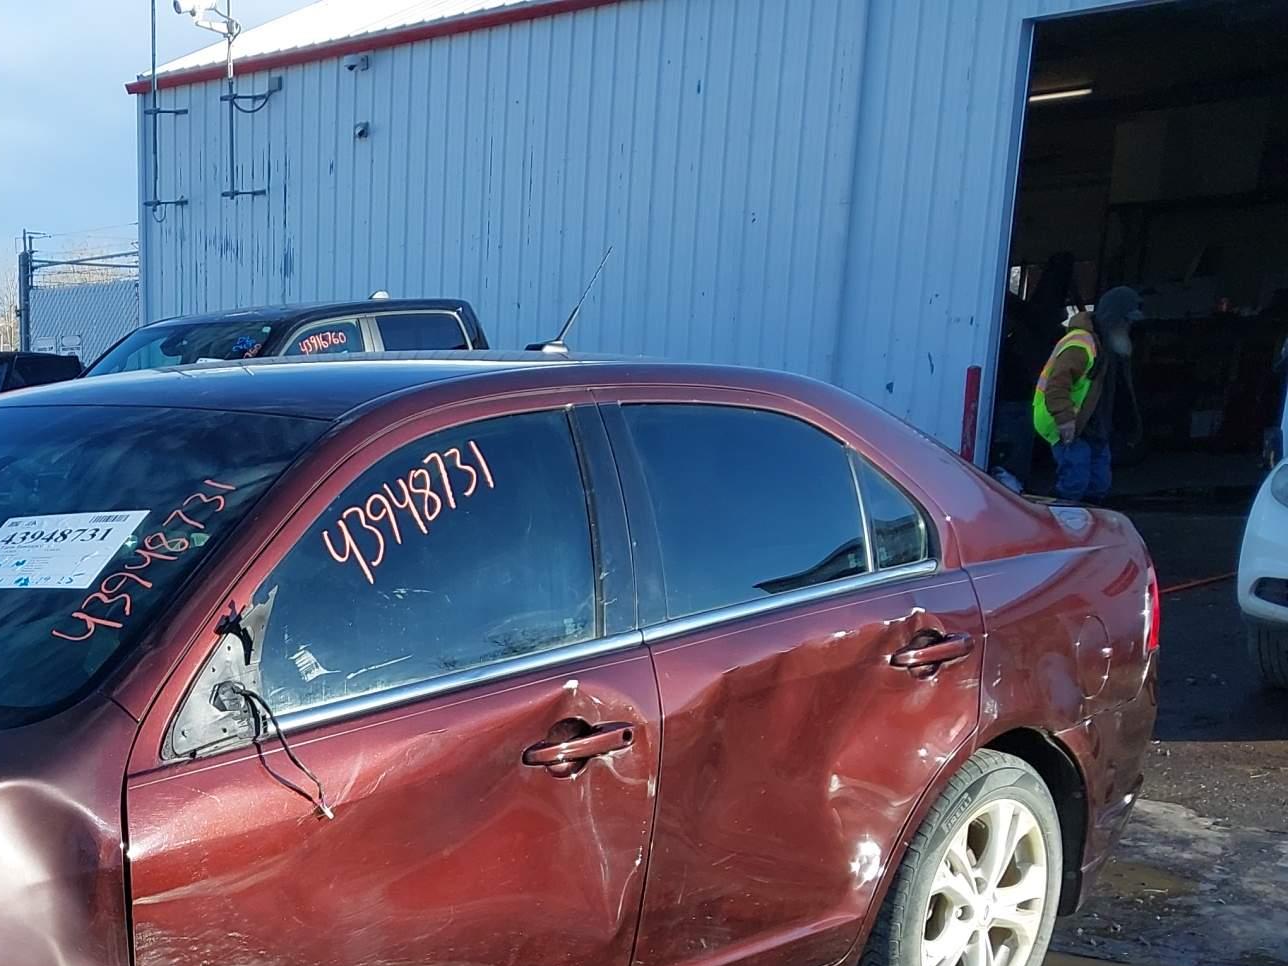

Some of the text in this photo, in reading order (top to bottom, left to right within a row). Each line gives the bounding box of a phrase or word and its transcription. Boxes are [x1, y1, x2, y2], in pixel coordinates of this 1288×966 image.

[299, 331, 347, 356] 43916760
[0, 527, 113, 545] 43948731
[322, 440, 495, 585] 43948731
[52, 479, 236, 641] 43948731
